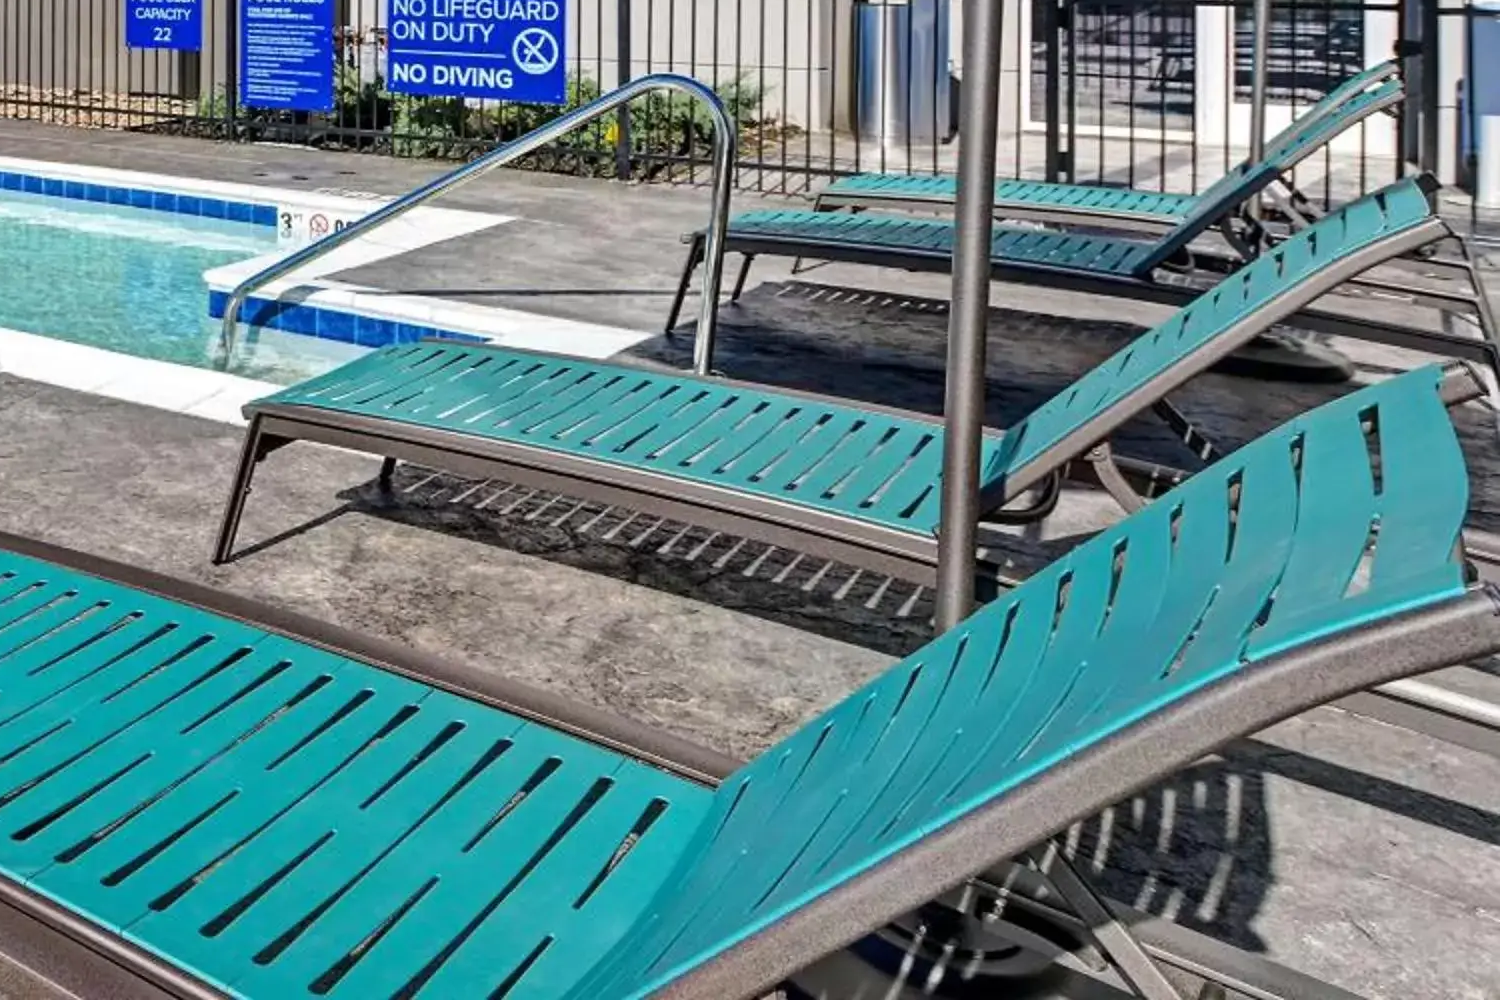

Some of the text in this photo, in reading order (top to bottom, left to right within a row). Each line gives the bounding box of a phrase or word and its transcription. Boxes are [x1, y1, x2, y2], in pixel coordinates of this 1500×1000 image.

[135, 7, 192, 21] CAPACITY
[153, 27, 172, 41] 22
[392, 19, 495, 44] ON DUTY
[393, 63, 513, 89] NO DIVING
